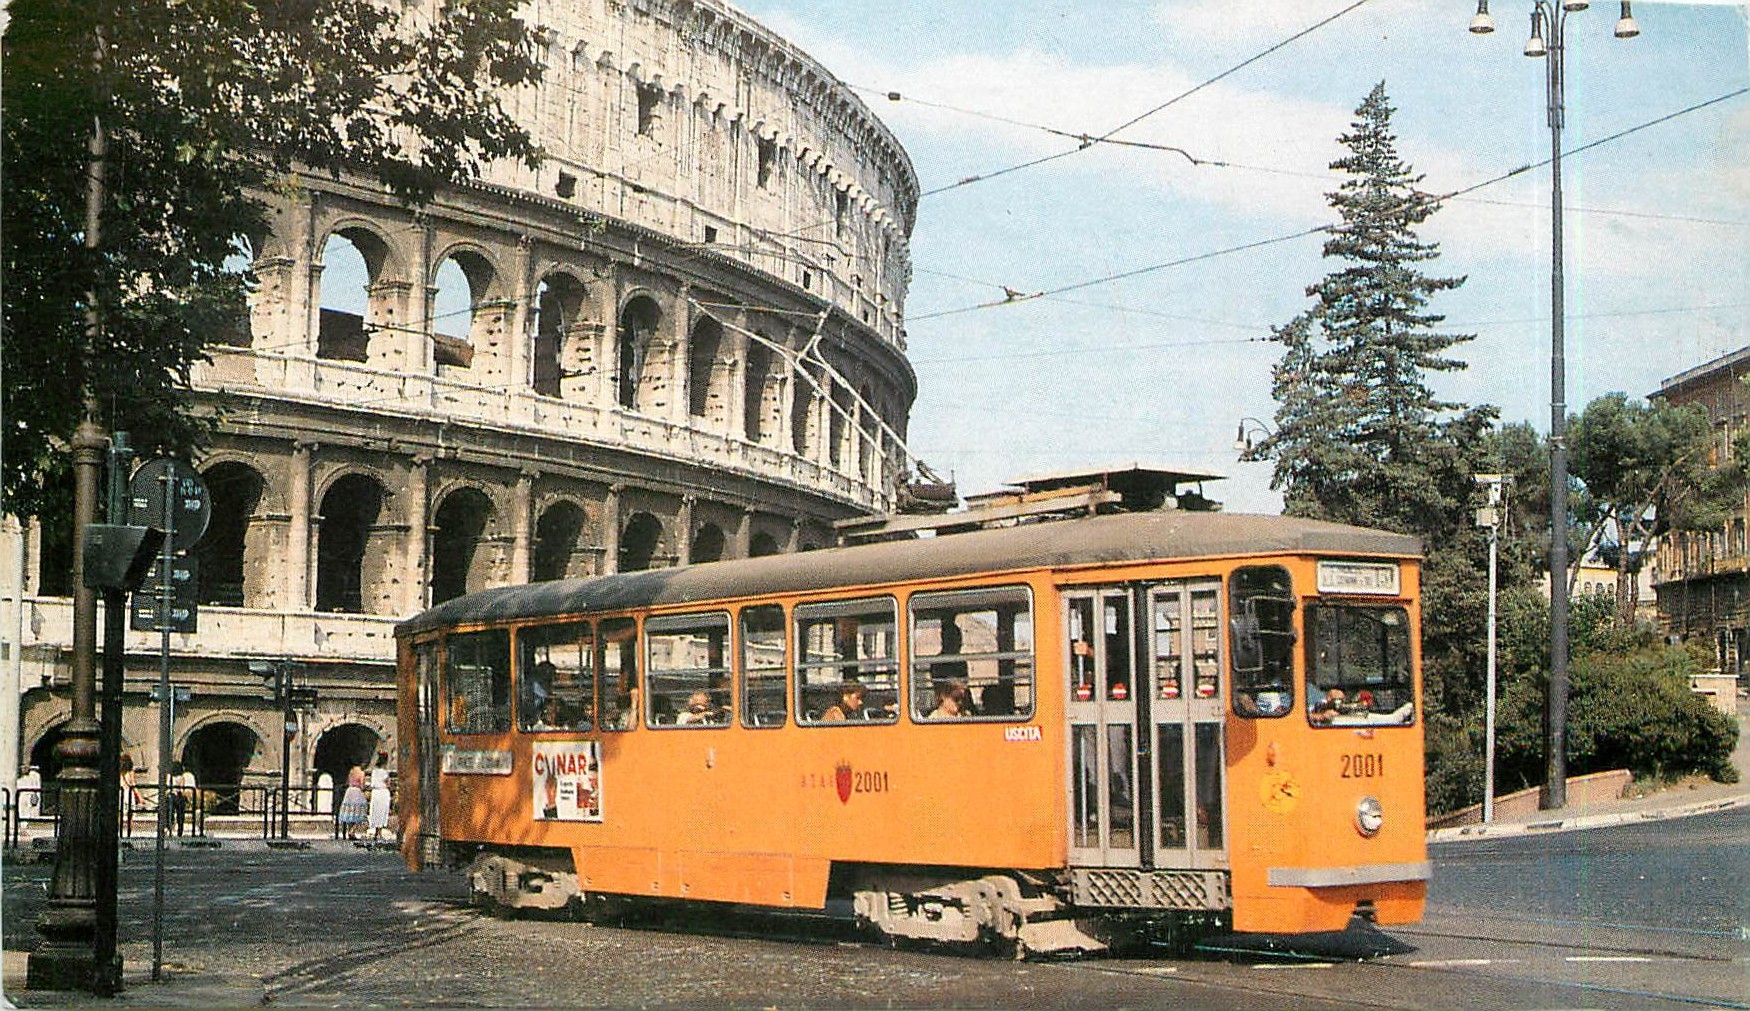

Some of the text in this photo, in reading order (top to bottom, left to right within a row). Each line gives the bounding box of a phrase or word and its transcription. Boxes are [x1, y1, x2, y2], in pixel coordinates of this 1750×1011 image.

[1004, 725, 1042, 741] USCITA
[534, 752, 587, 776] CYNAR
[1340, 753, 1384, 778] 2001
[854, 771, 889, 793] 2001
